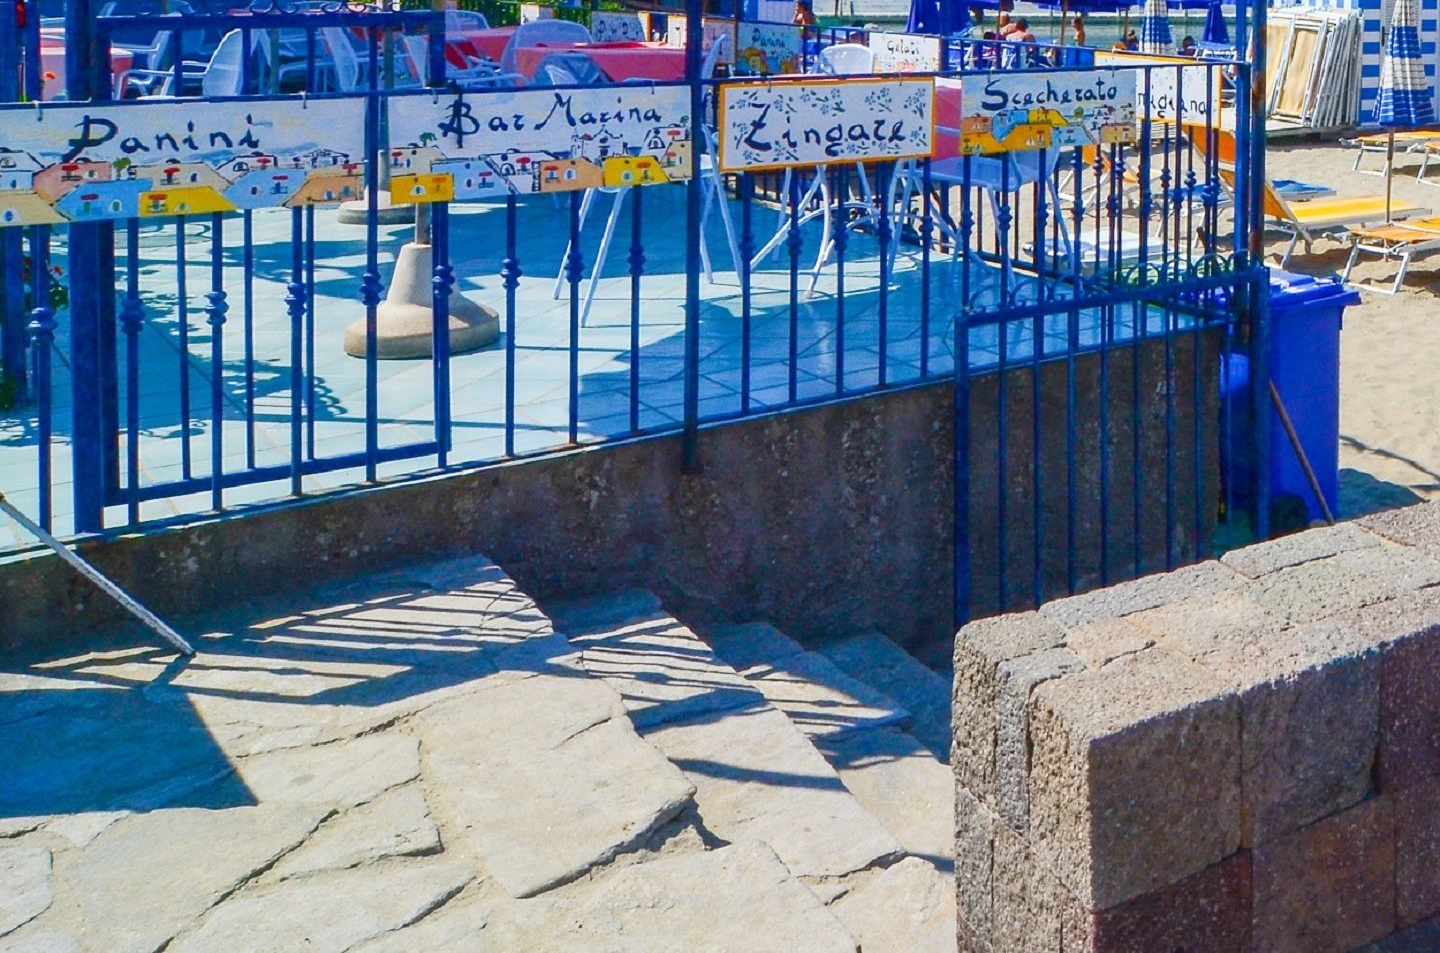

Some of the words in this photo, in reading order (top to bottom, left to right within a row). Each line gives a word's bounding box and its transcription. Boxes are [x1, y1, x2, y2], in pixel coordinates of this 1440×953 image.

[60, 114, 261, 164] Panini
[437, 96, 525, 149] Bar
[533, 92, 663, 132] Marina
